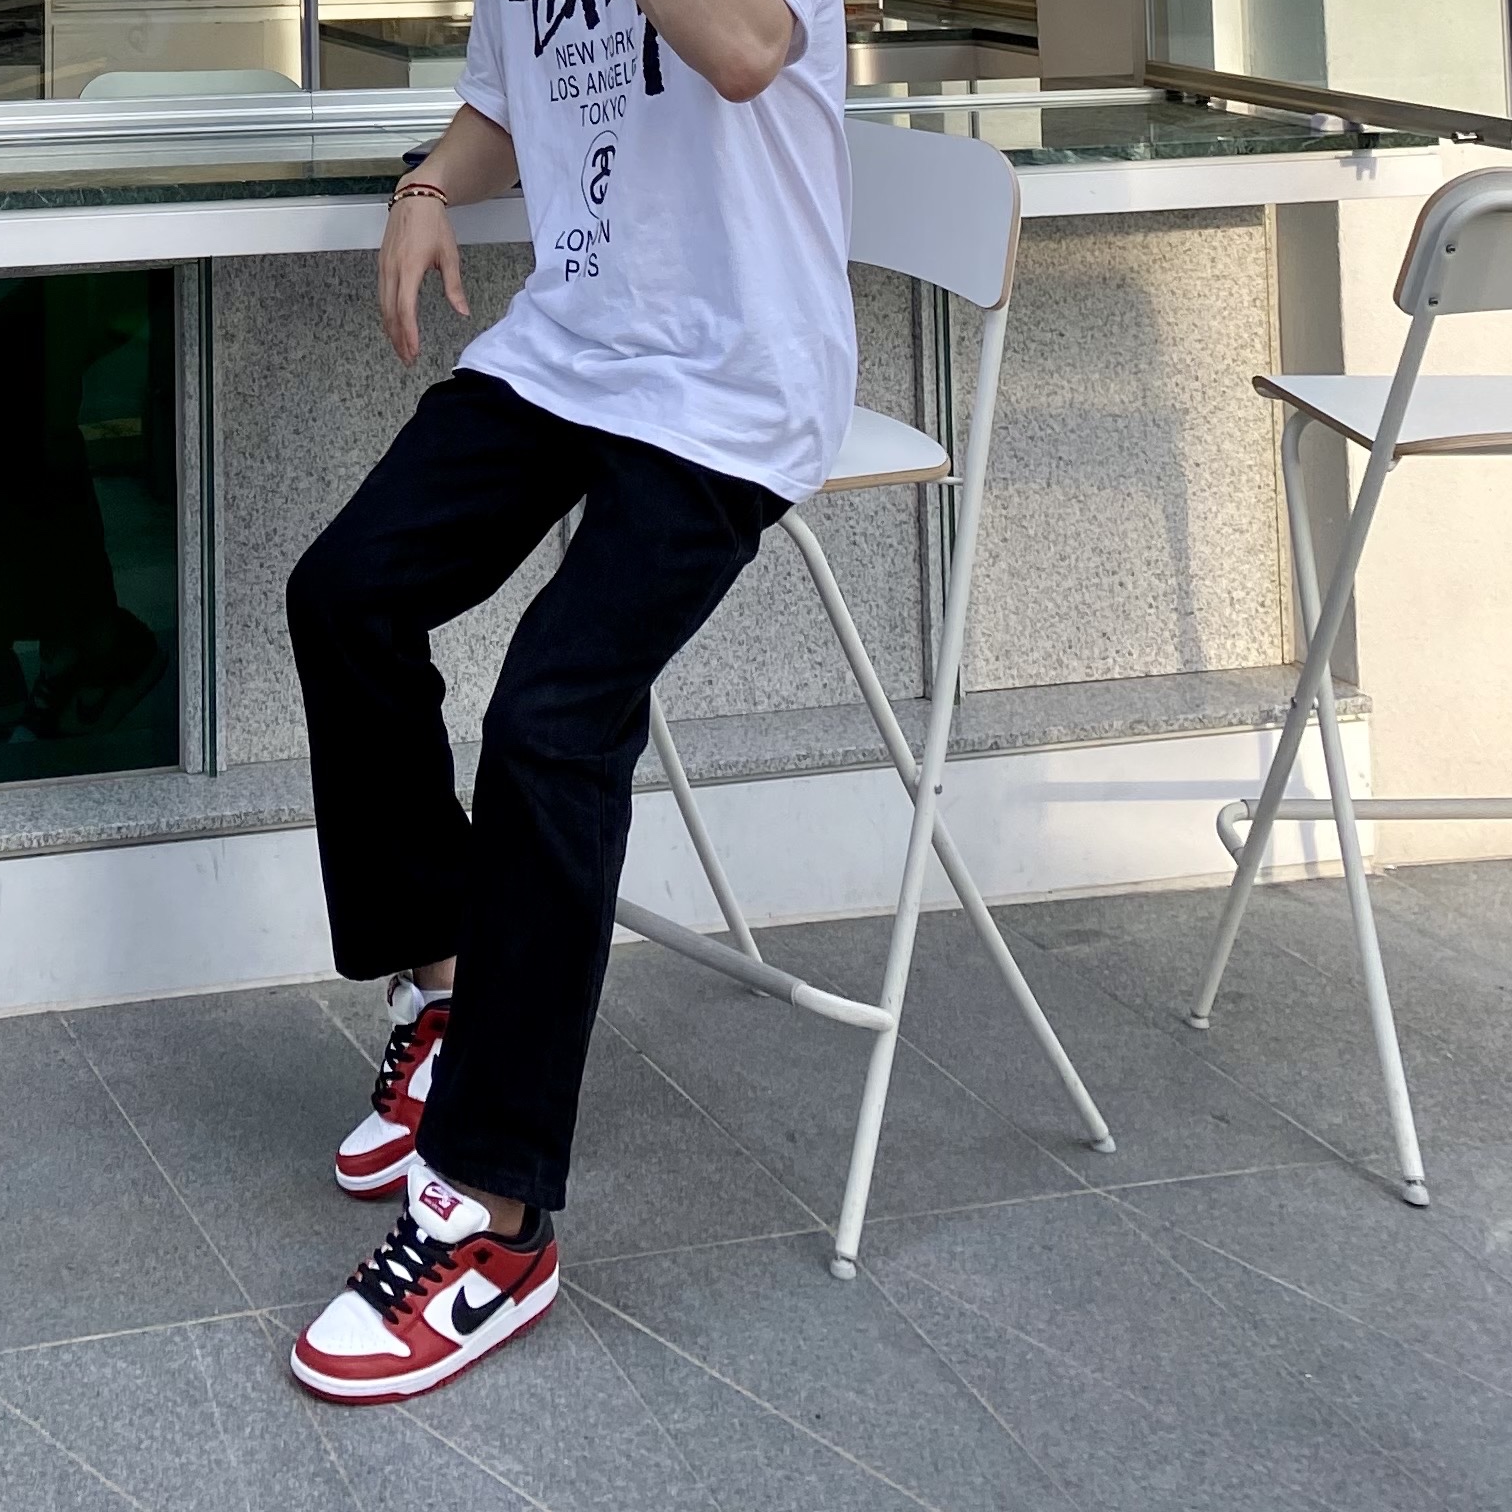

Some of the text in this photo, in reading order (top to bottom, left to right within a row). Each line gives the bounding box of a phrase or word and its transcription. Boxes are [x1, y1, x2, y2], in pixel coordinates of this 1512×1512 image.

[555, 27, 635, 69] NEW YORK
[549, 54, 638, 102] LOS ANGEL
[579, 94, 627, 127] TOKYO
